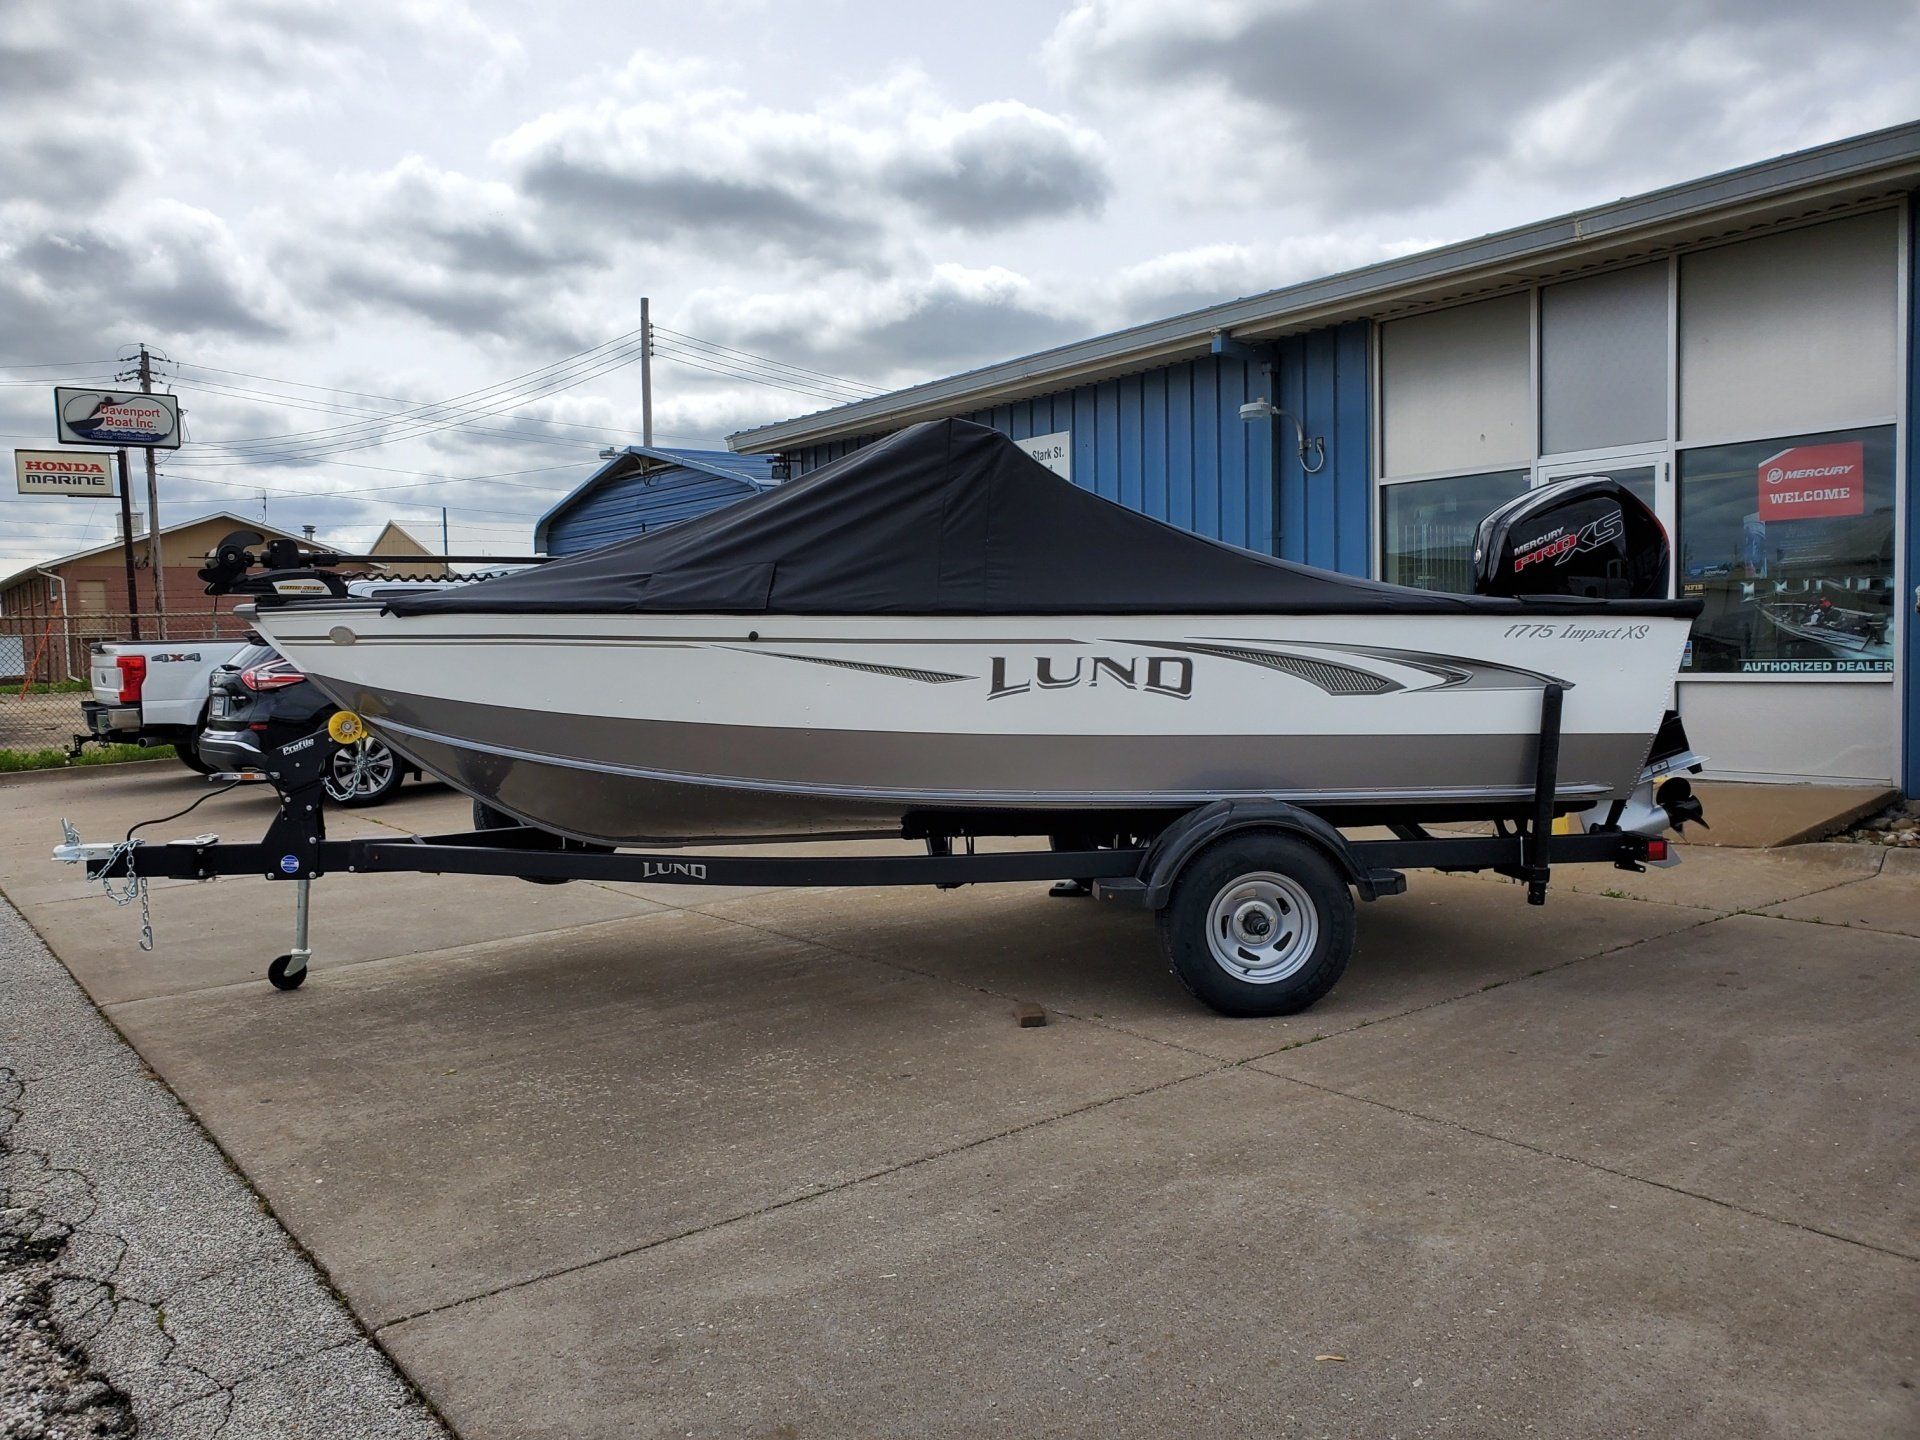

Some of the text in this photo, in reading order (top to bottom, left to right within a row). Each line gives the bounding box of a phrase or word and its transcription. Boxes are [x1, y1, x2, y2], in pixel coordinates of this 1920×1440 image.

[100, 405, 160, 418] Davenport
[105, 416, 157, 428] Boat Inc.
[1032, 446, 1065, 461] Stark St.
[25, 461, 104, 473] HONDA
[1784, 464, 1855, 479] MERCURY
[1769, 487, 1850, 504] WELCOME
[1514, 526, 1564, 556] MERCURY
[1514, 509, 1624, 573] PRO XS
[1503, 624, 1650, 642] 1775 Impact XS
[1743, 661, 1894, 672] AUTHORIZED DEALER
[986, 656, 1193, 701] LUND
[282, 738, 315, 756] Profile
[642, 862, 707, 880] LUND
